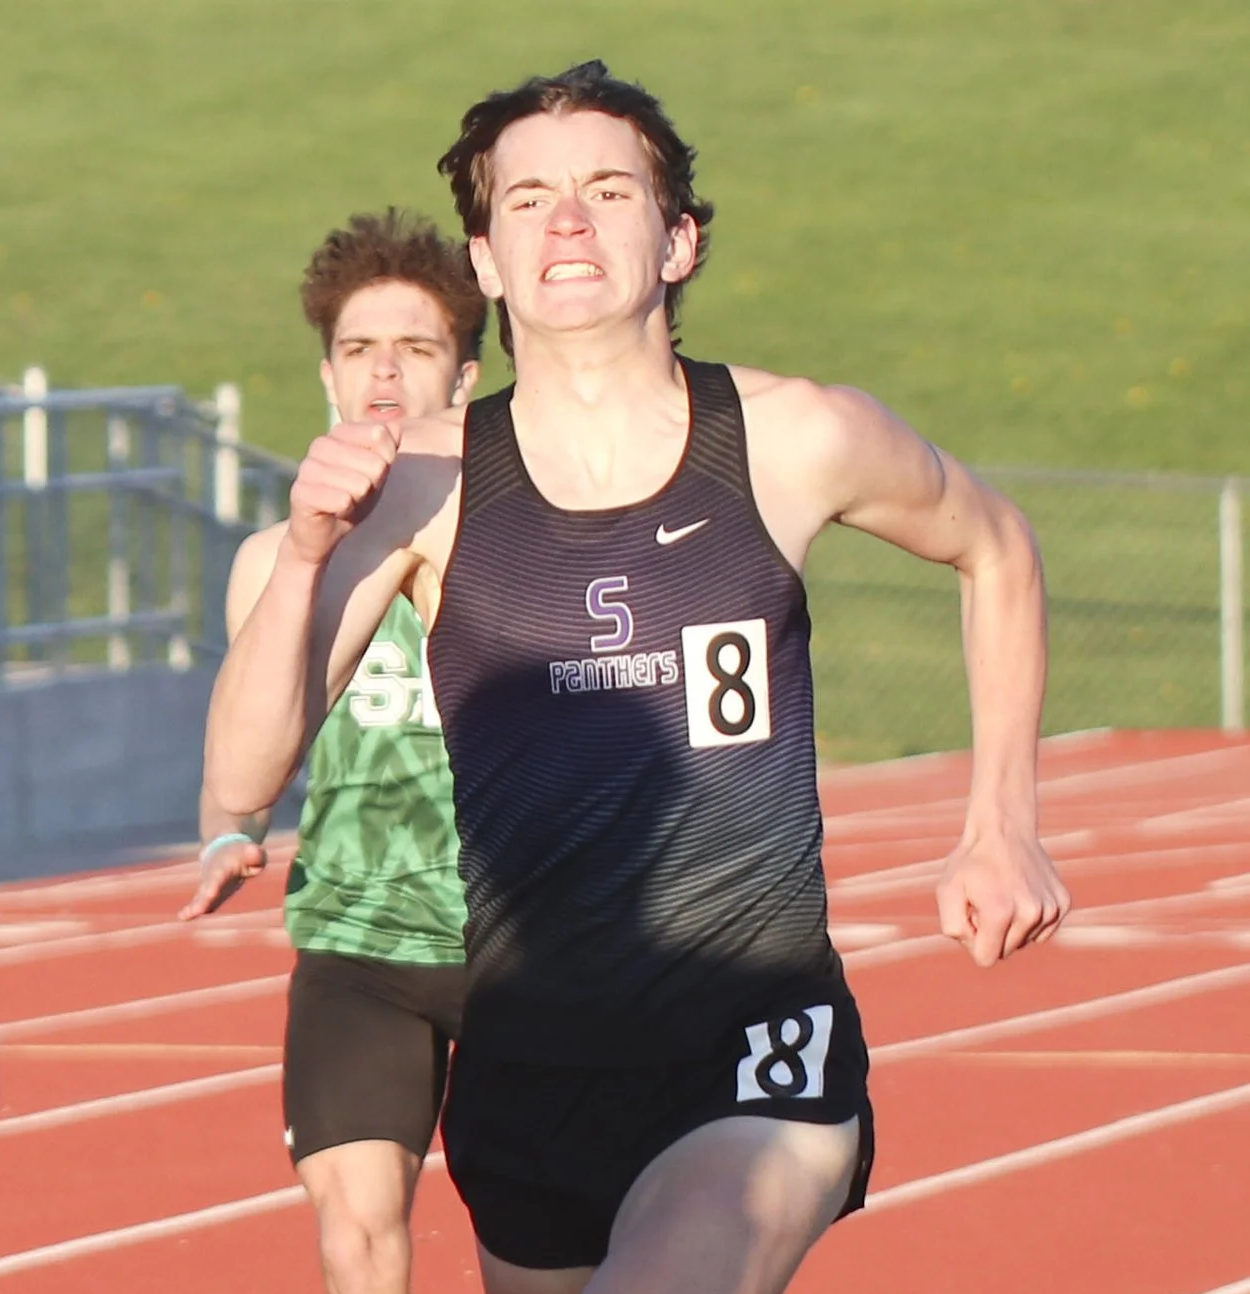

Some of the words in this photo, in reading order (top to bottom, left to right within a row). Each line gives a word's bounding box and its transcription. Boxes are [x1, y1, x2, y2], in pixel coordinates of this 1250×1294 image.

[586, 575, 633, 653] S
[706, 631, 756, 736] 8
[755, 1008, 814, 1100] 8
